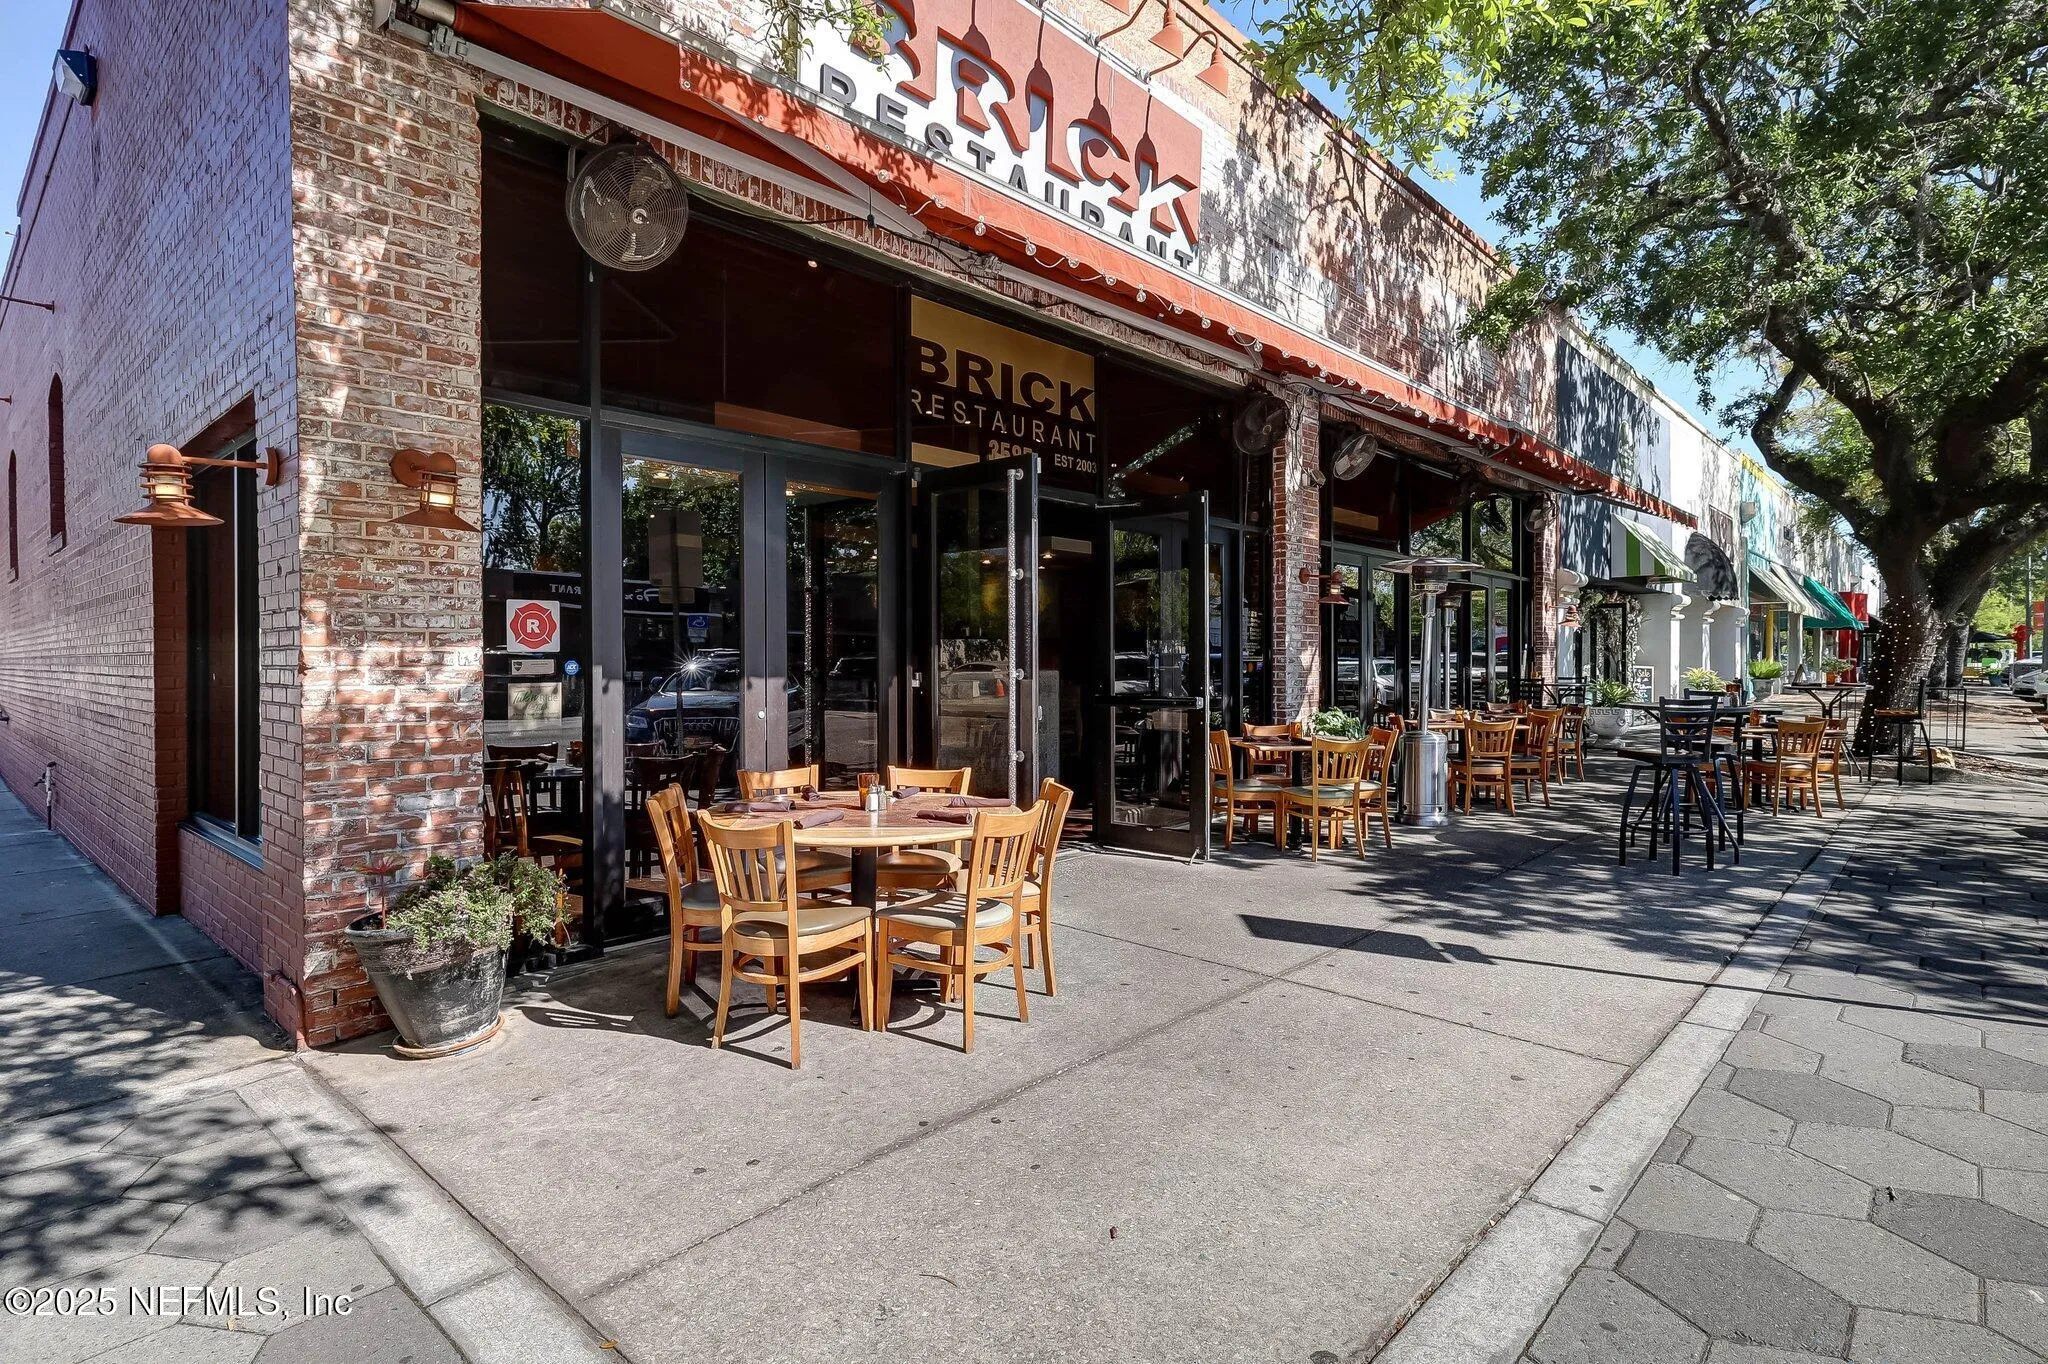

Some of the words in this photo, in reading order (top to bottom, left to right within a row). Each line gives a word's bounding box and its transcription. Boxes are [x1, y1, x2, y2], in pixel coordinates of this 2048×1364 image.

[911, 336, 1095, 422] BRICK
[911, 389, 1096, 453] RESTAURANT
[1054, 453, 1074, 469] EST
[1076, 458, 1097, 474] 2003
[526, 618, 541, 634] R
